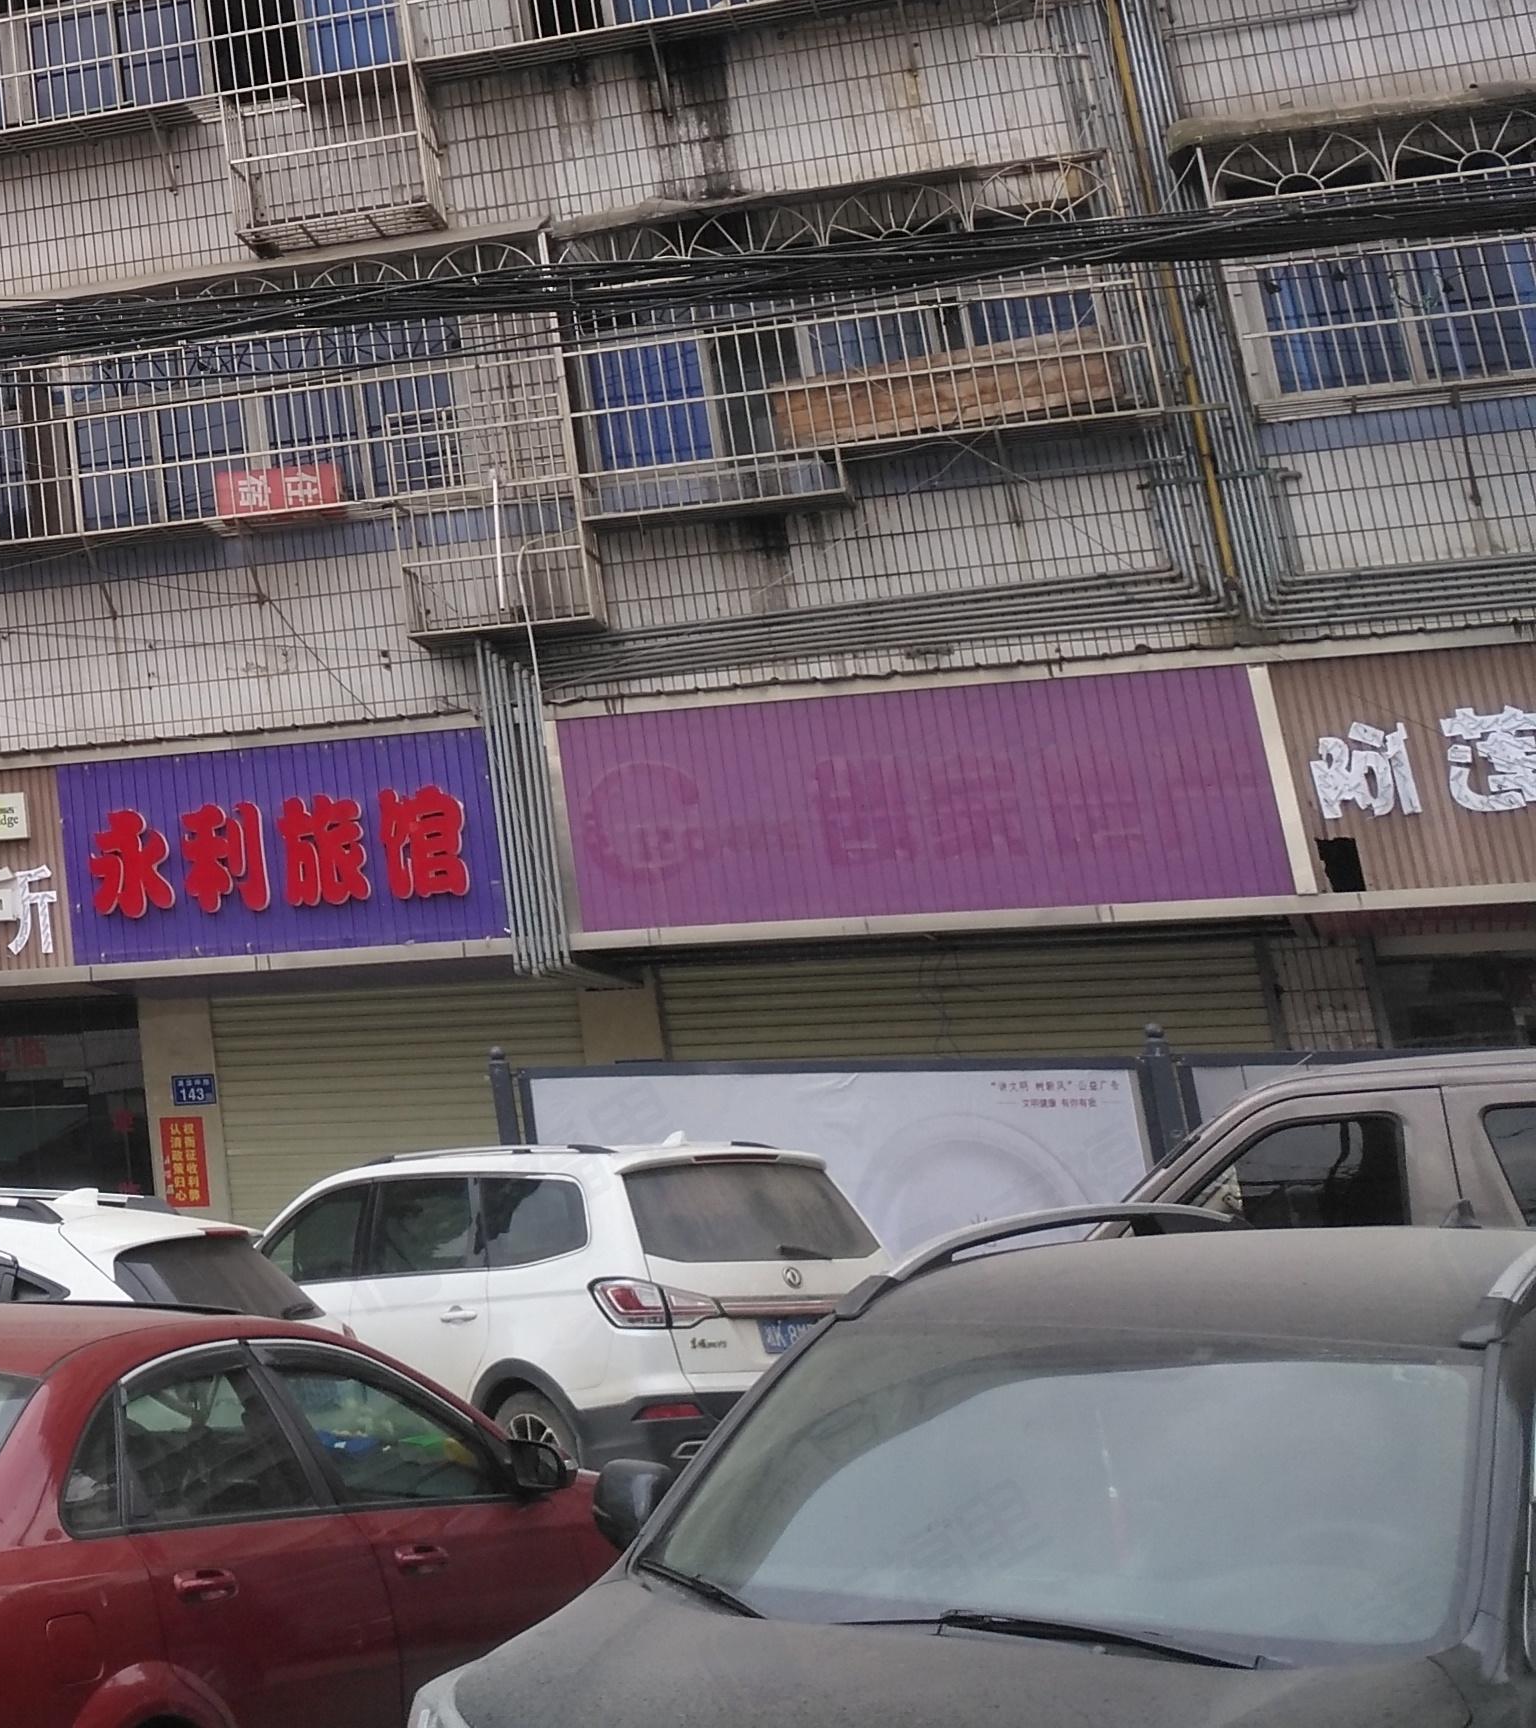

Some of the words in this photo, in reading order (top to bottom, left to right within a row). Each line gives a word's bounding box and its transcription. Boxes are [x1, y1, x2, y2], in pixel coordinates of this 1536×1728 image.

[89, 783, 471, 919] 永利旅馆
[180, 1087, 205, 1101] 143
